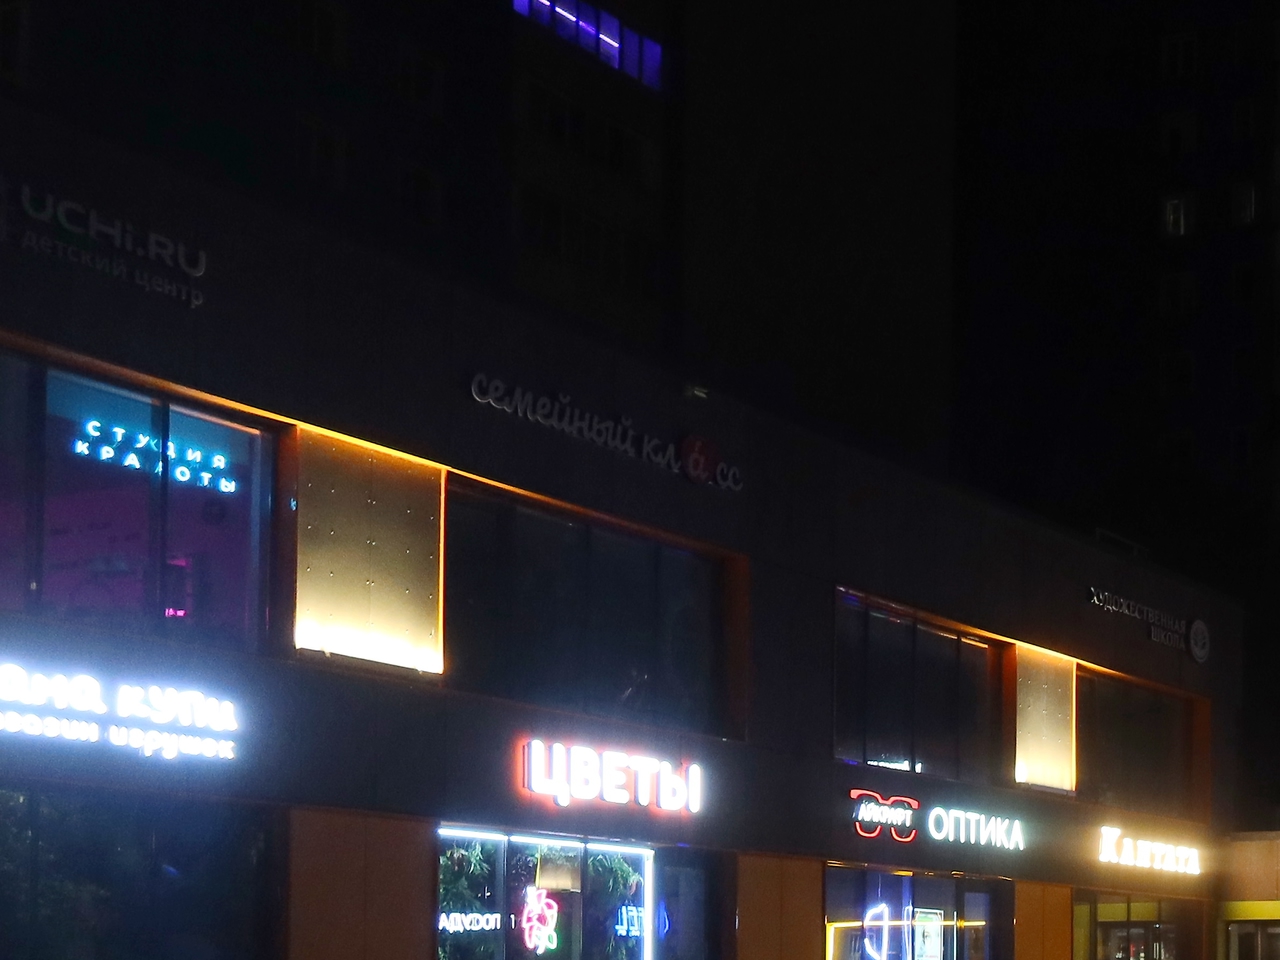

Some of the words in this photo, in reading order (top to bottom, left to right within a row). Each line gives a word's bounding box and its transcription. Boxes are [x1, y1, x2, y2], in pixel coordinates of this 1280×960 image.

[21, 230, 128, 280] детский
[134, 270, 204, 309] центр
[471, 373, 636, 458] семейный
[1090, 586, 1186, 634] ХУДОЖЕСТВЕННАЯ
[1151, 625, 1186, 652] ШКОЛА
[526, 738, 701, 813] ЦВЕТЫ
[928, 806, 1024, 851] ОПТИКА
